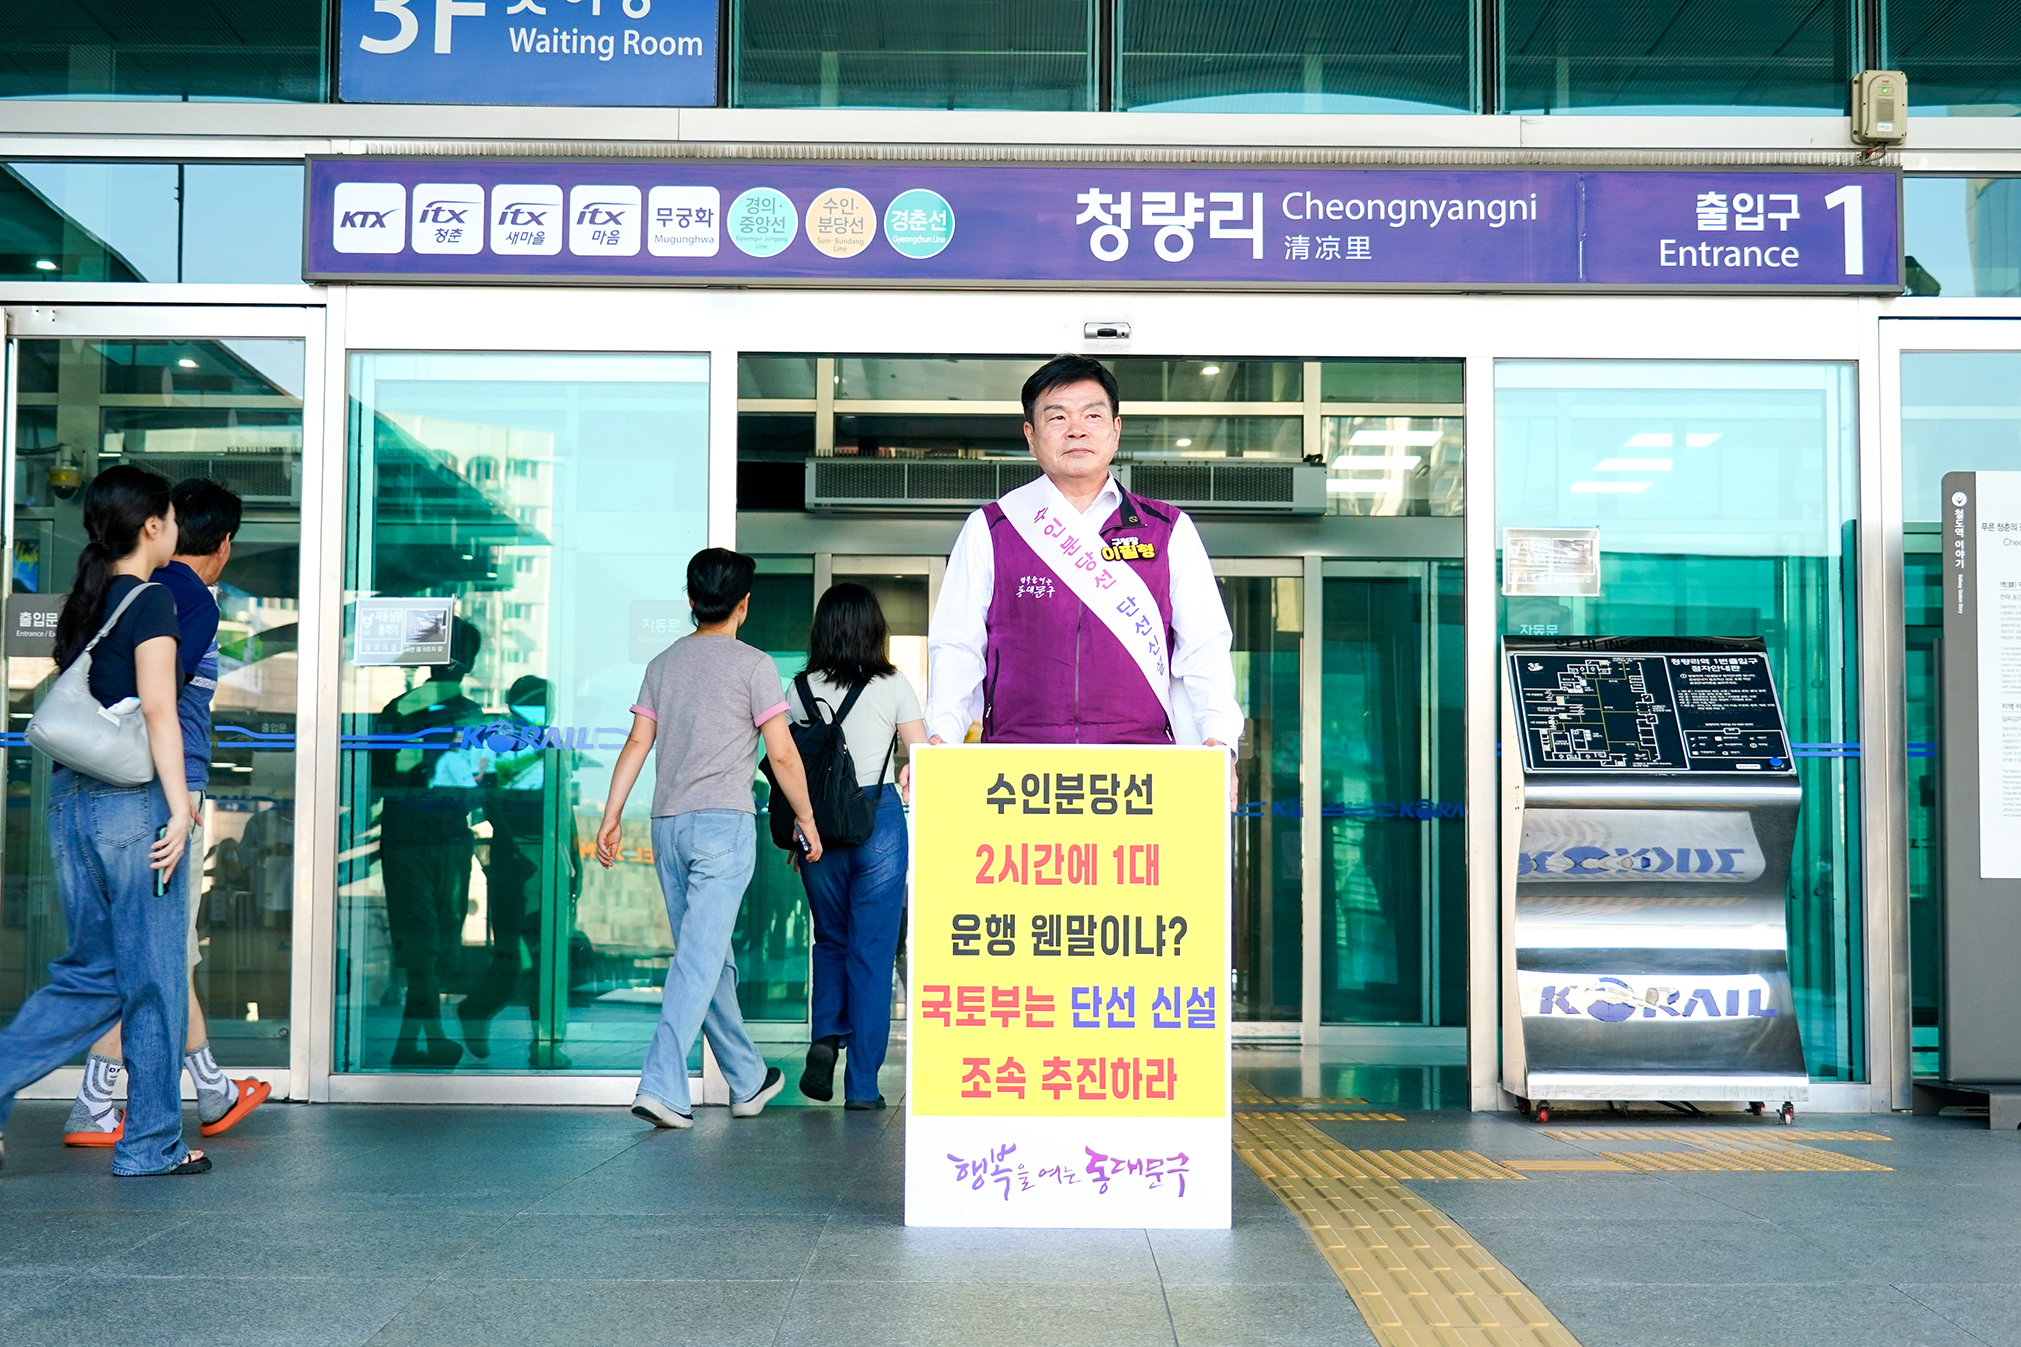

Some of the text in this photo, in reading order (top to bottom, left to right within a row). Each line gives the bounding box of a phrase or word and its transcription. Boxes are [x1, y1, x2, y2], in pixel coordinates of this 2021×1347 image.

[509, 28, 702, 61] Waiting Room
[340, 208, 396, 228] KTX
[656, 207, 715, 228] 무궁화
[890, 209, 947, 232] 경춘선
[1283, 190, 1537, 228] Cheongnyangni
[1696, 191, 1800, 232] 출입구
[434, 228, 463, 243] 청춘
[506, 231, 545, 245] 새마을
[591, 231, 621, 245] 마음
[739, 216, 786, 234] 중앙선
[817, 217, 864, 235] 분당선
[1076, 188, 1263, 262] 청량리
[1825, 186, 1863, 275] 1
[654, 235, 714, 246] Mugunghwa
[892, 235, 947, 246] Gyeongchun Line
[1284, 234, 1372, 261] 清凉里
[1660, 239, 1799, 268] Entrance
[1955, 540, 1965, 569] 이야기
[1016, 585, 1055, 598] 동대문구
[19, 611, 58, 628] 출입문
[642, 618, 681, 634] 자동문
[16, 630, 44, 638] Entrance
[459, 719, 594, 752] KORAIL
[987, 773, 1153, 815] 수인분당선
[976, 843, 1159, 885] 2시간에 1대
[951, 914, 1187, 957] 운행 웬말이냐?
[922, 985, 1216, 1029] 국토부는 단선 신설
[961, 1056, 1177, 1100] 조속 추진하라
[1039, 1165, 1081, 1184] 여는
[1085, 1146, 1189, 1198] 동대문구
